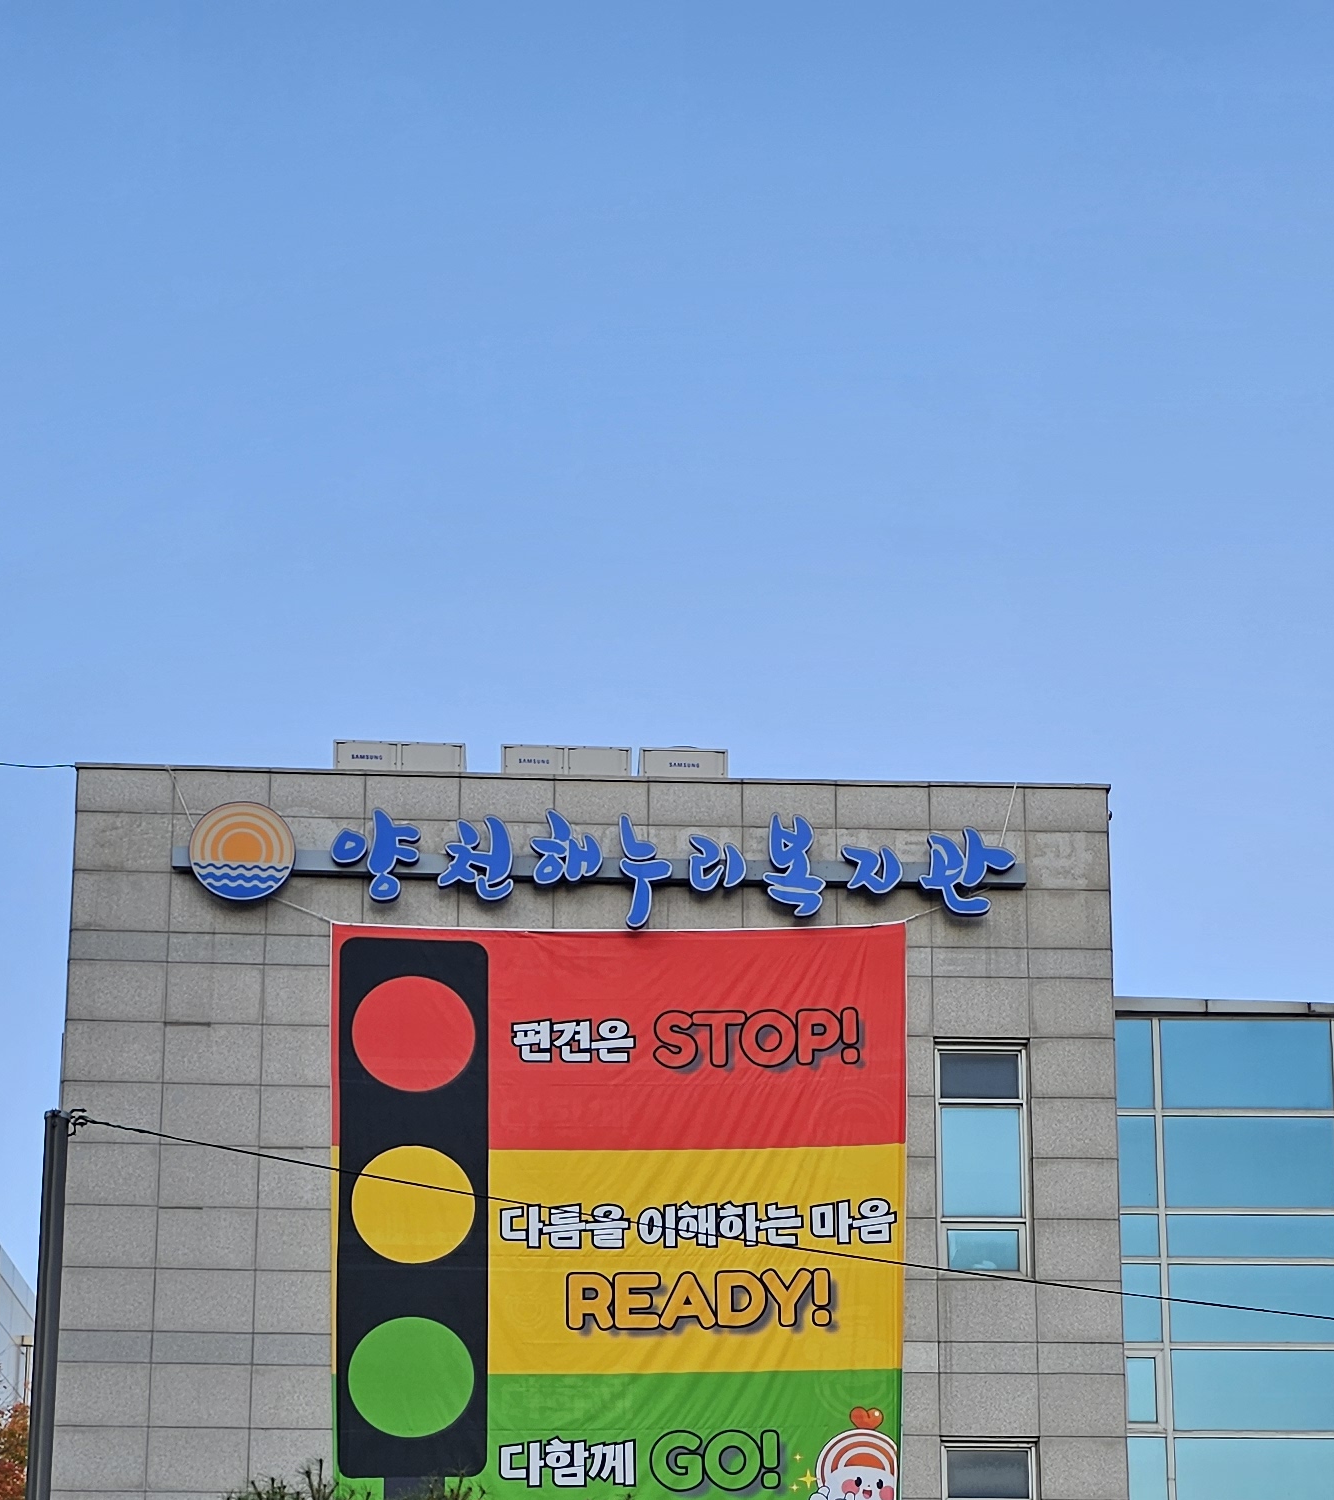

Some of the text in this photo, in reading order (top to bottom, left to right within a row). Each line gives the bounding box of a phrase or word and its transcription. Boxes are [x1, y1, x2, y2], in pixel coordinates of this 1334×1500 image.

[331, 808, 1017, 930] 양천해누리복지관
[511, 1007, 863, 1069] 편견은 STOP!
[500, 1198, 896, 1249] 다름을 이해하는 마음
[566, 1268, 833, 1332] READY!
[499, 1429, 782, 1490] 다함께 GO!
